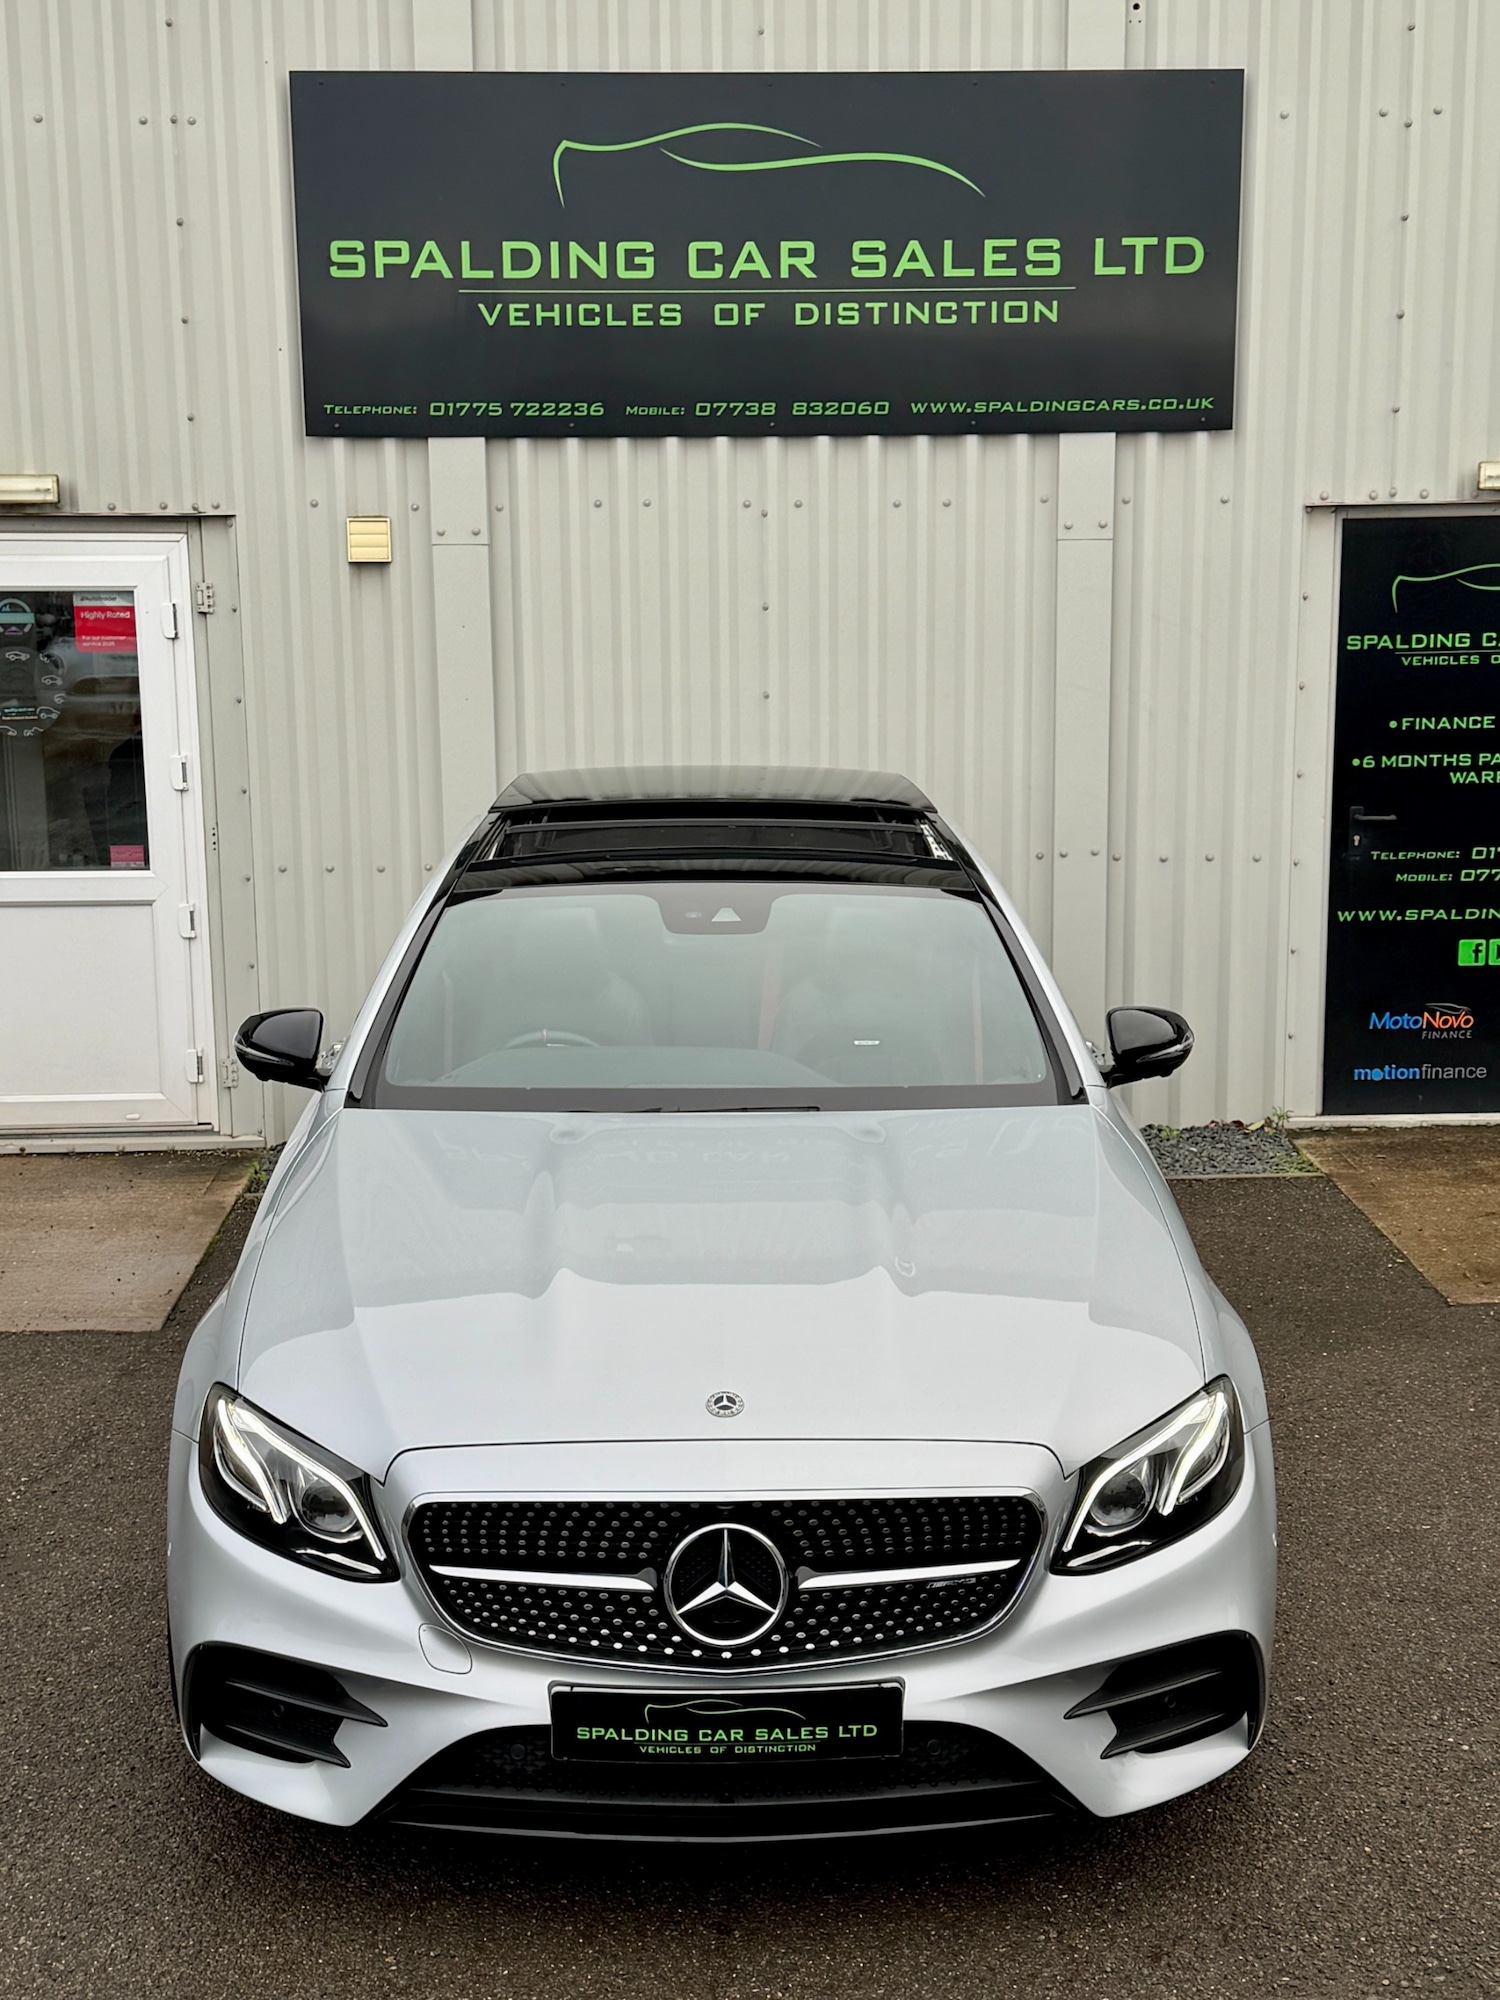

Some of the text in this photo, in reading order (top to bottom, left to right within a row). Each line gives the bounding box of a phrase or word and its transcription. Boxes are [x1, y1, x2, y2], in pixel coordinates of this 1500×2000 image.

[329, 236, 1206, 279] SPALDING CAR SALES LTD
[477, 300, 1059, 327] VEHICLES OF DISTINCTION
[429, 402, 503, 417] 01775
[510, 402, 605, 417] 722236
[694, 402, 777, 417] 07738
[791, 401, 890, 416] 832060
[910, 397, 1215, 415] WWW.SPALDINGCARS.CO.UK
[80, 611, 131, 620] Highly Rated
[1346, 631, 1500, 650] SPALDING C
[1401, 655, 1480, 666] VEHICLES
[1401, 715, 1496, 730] FINANCE
[1381, 753, 1472, 768] MONTHS
[1471, 846, 1500, 860] 01
[1369, 1011, 1475, 1030] MotoNovo
[1421, 1029, 1473, 1040] FINANCE
[576, 1724, 879, 1742] SPALDING CAR SALES LTD
[639, 1744, 817, 1755] VEHICLES OF DISTINCTION
